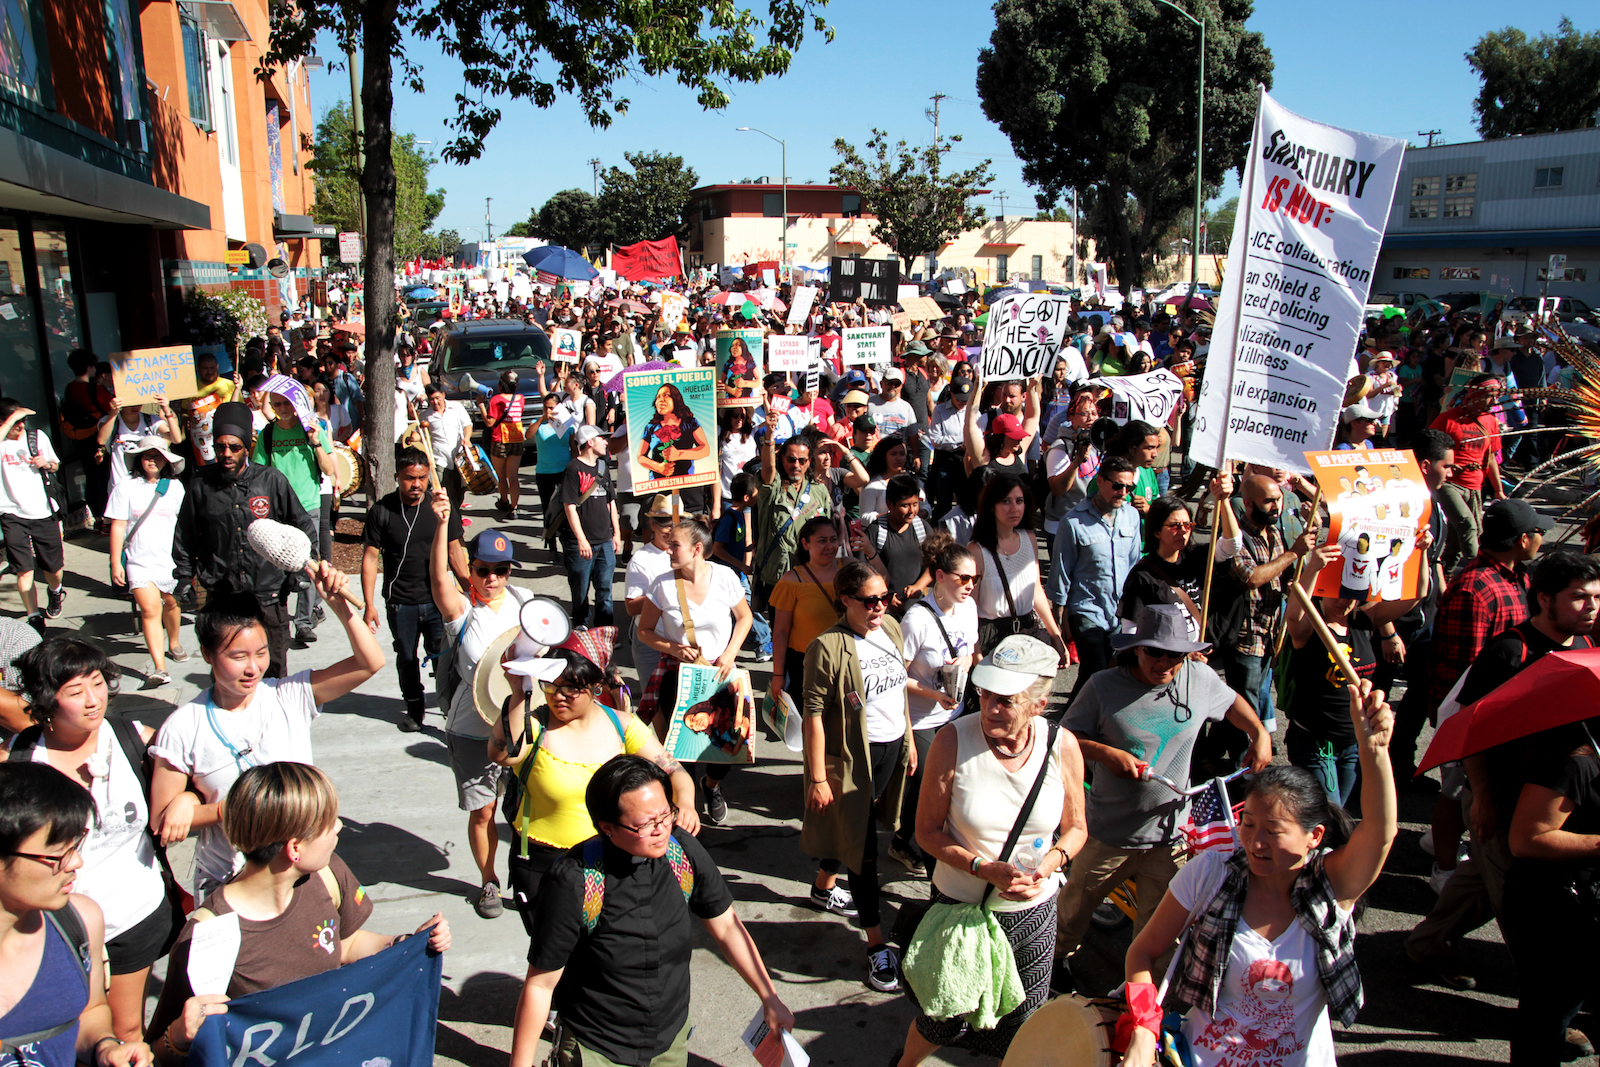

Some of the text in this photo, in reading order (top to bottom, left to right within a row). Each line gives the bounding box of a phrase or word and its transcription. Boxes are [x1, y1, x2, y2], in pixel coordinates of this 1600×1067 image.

[1263, 129, 1376, 199] SANCTUARY
[1262, 175, 1335, 228] IS NOT:
[841, 260, 855, 275] NO
[1275, 241, 1370, 283] collaboration
[1245, 271, 1321, 303] an Shield &
[1244, 288, 1330, 331] ized policing
[986, 297, 1068, 346] WE GOT
[846, 332, 886, 340] SANCTUARY
[996, 325, 1034, 347] THE
[1240, 324, 1314, 358] lization of
[111, 352, 195, 372] VIETNAMESE
[868, 350, 877, 358] 54
[981, 343, 1060, 378] AUDACITY
[1244, 346, 1289, 371] illness
[125, 367, 179, 385] AGAINST
[627, 371, 712, 387] SOMOS EL PUEBLO
[136, 383, 166, 397] WAR
[683, 385, 712, 393] ¡HUELGA!
[1234, 380, 1318, 413] il expansion
[770, 396, 791, 412] NO!
[1229, 415, 1309, 444] splacement
[271, 438, 306, 448] SOCCER
[1315, 451, 1408, 465] NO PAPERS. NO FEAR.
[636, 472, 716, 491] RESPETA NUESTRA HUMANIDAD
[1359, 524, 1411, 538] UNDOCUMENTED
[939, 630, 965, 644] NSTY
[885, 665, 895, 674] IS
[692, 669, 703, 701] ¡HUELGA!
[666, 667, 693, 757] SOMOS EL PUEBLO
[227, 992, 375, 1067] RLD
[1193, 1035, 1222, 1050] MY
